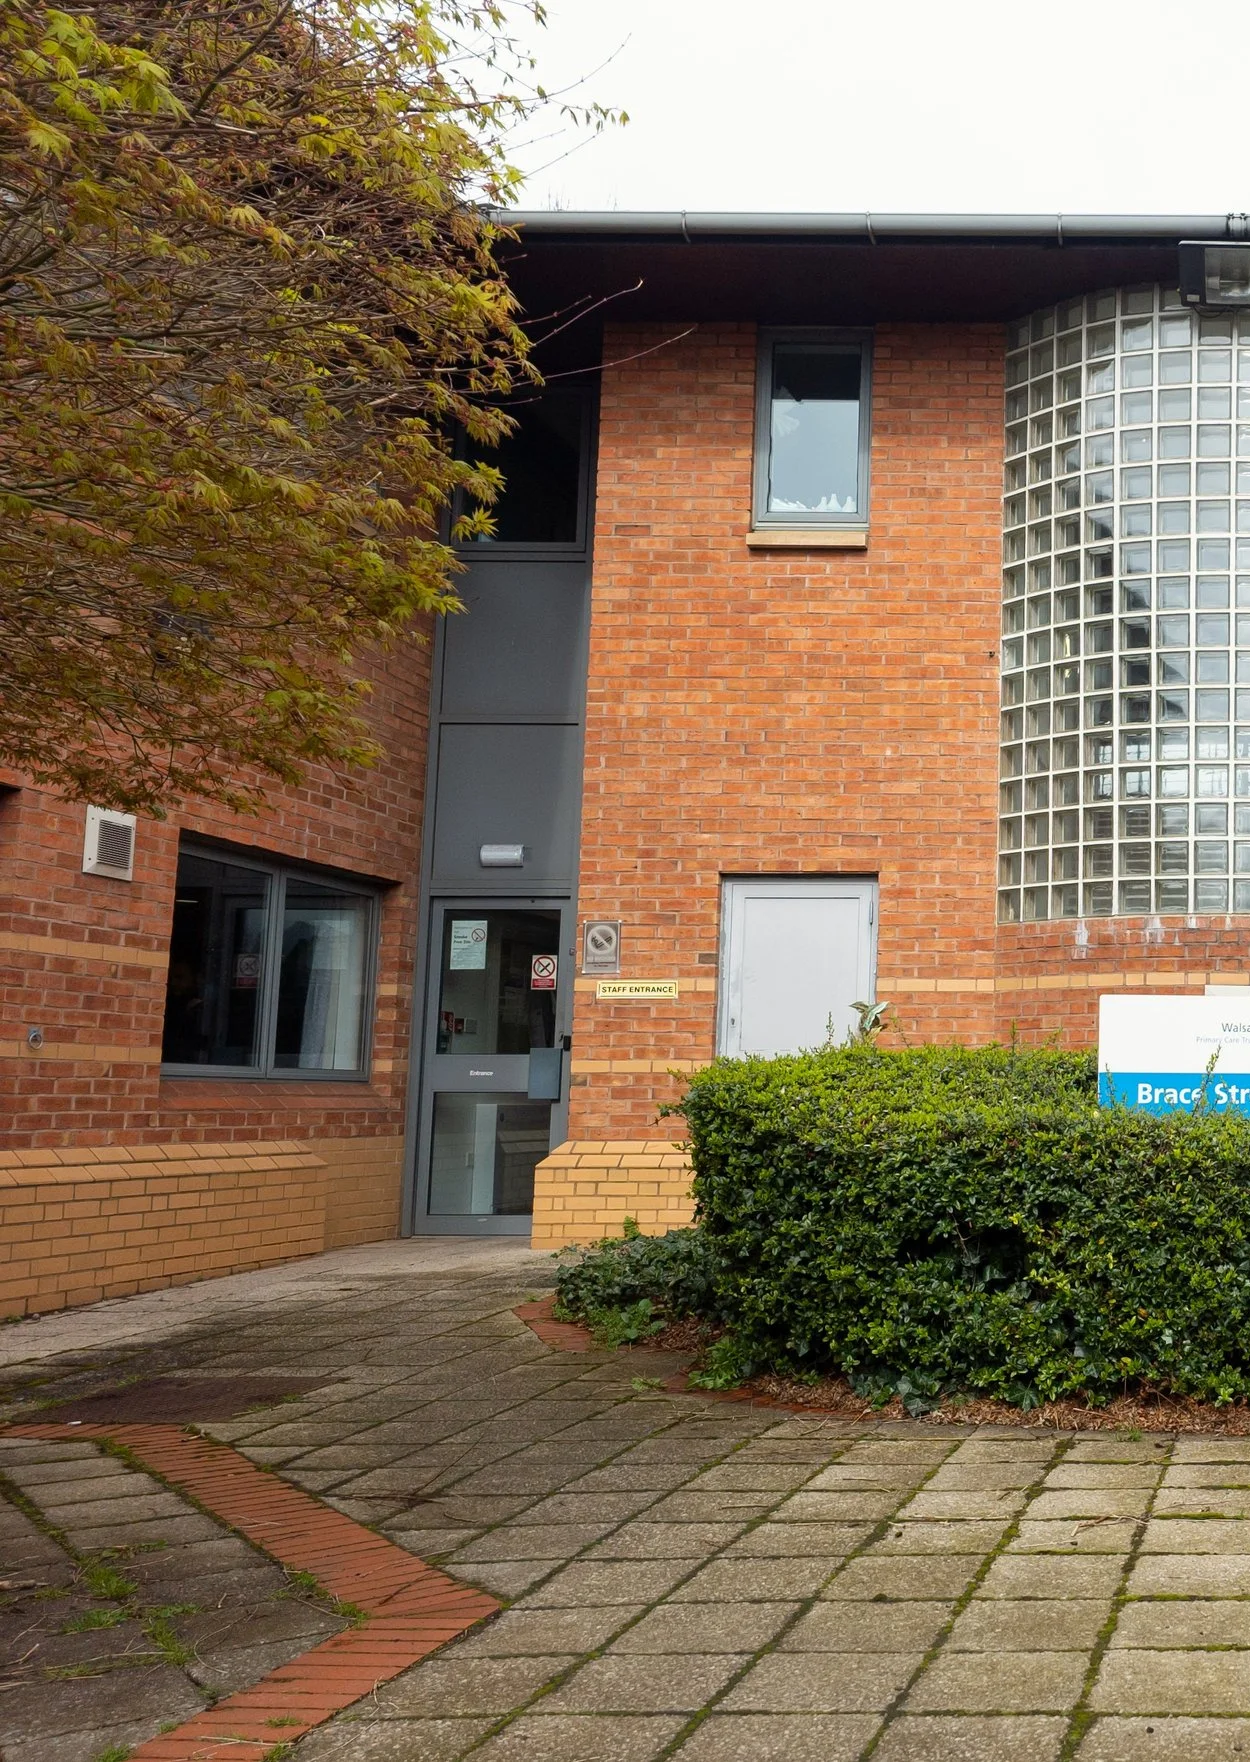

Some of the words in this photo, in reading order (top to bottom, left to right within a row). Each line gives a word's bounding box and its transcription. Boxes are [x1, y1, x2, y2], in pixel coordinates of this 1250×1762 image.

[1196, 1036, 1222, 1044] Primary
[1224, 1036, 1240, 1044] Care
[1137, 1083, 1203, 1105] Brace
